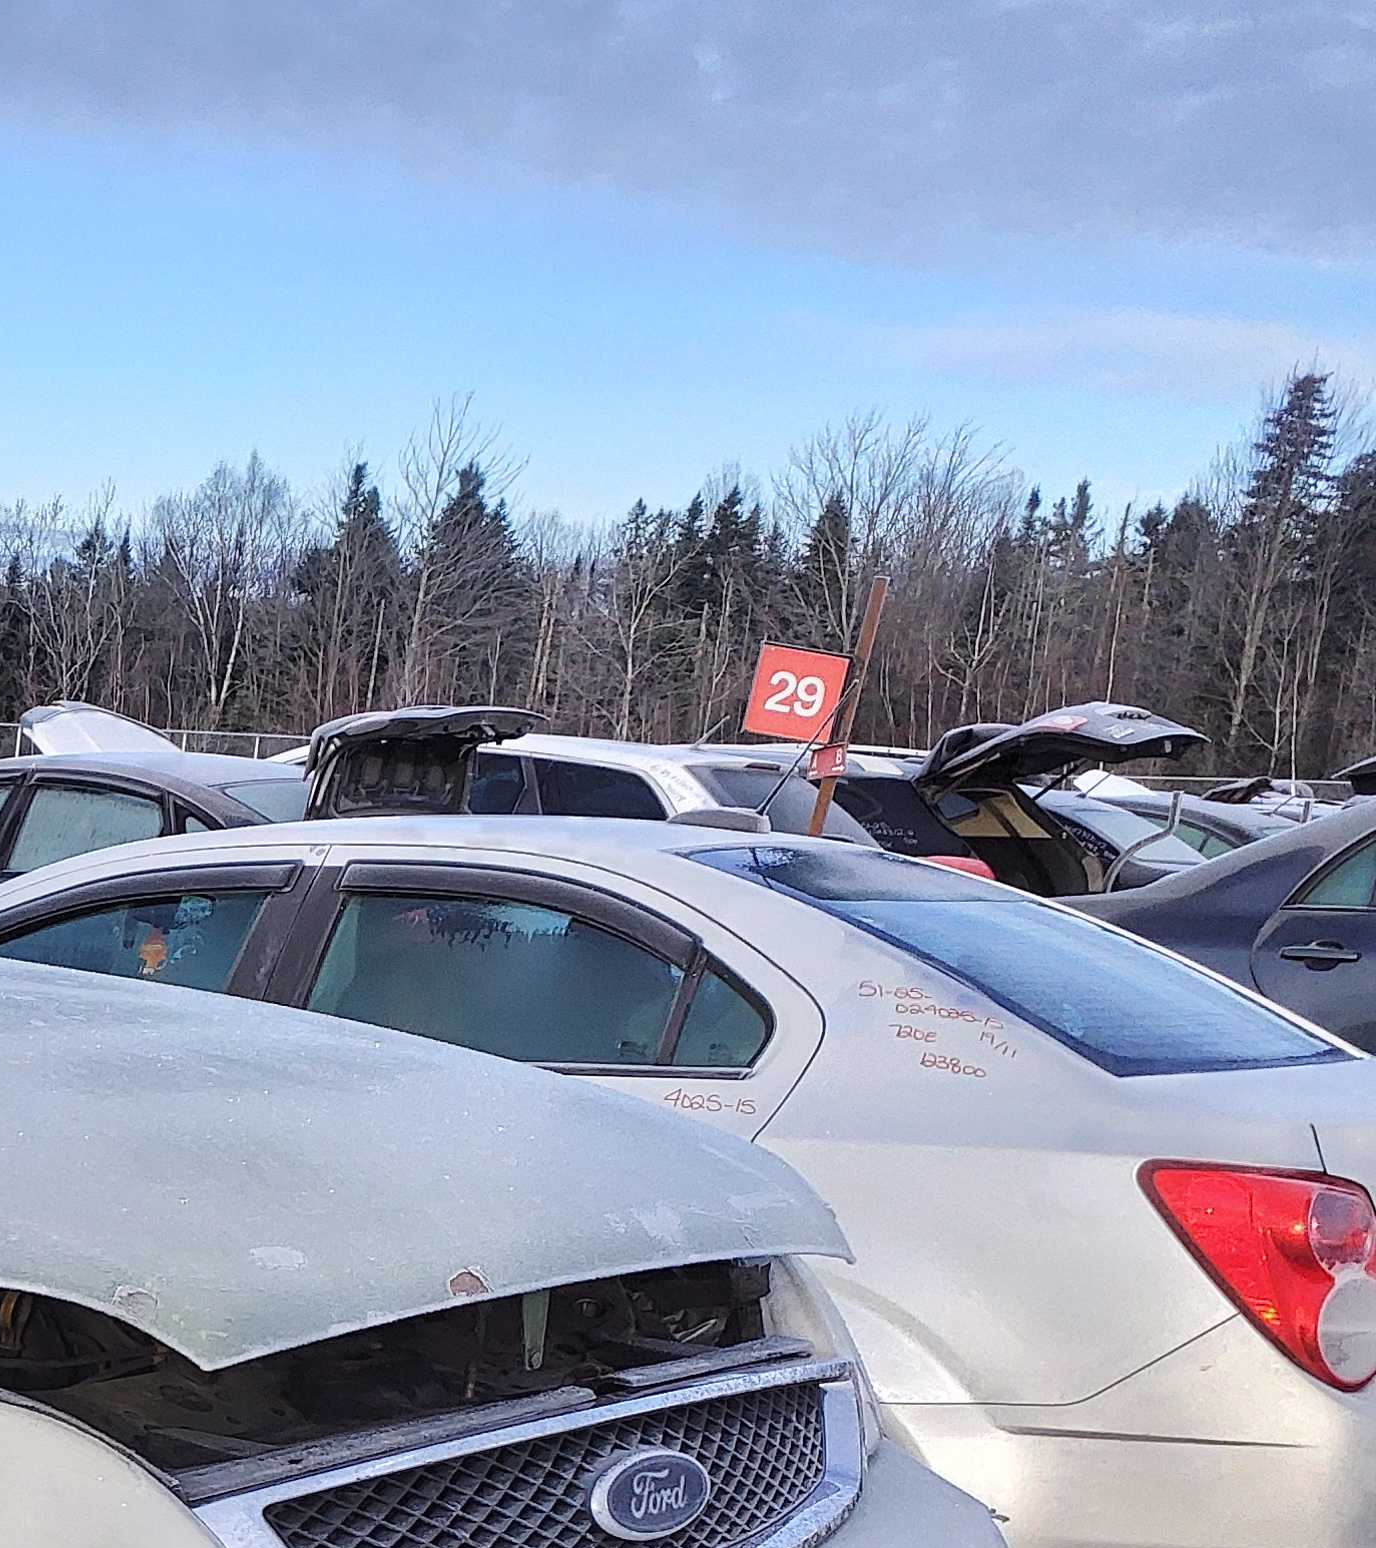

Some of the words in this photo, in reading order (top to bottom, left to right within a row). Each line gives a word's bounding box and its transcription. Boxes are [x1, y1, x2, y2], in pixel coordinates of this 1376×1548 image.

[763, 670, 826, 718] 29
[835, 748, 843, 764] B
[631, 1468, 688, 1519] Ford
